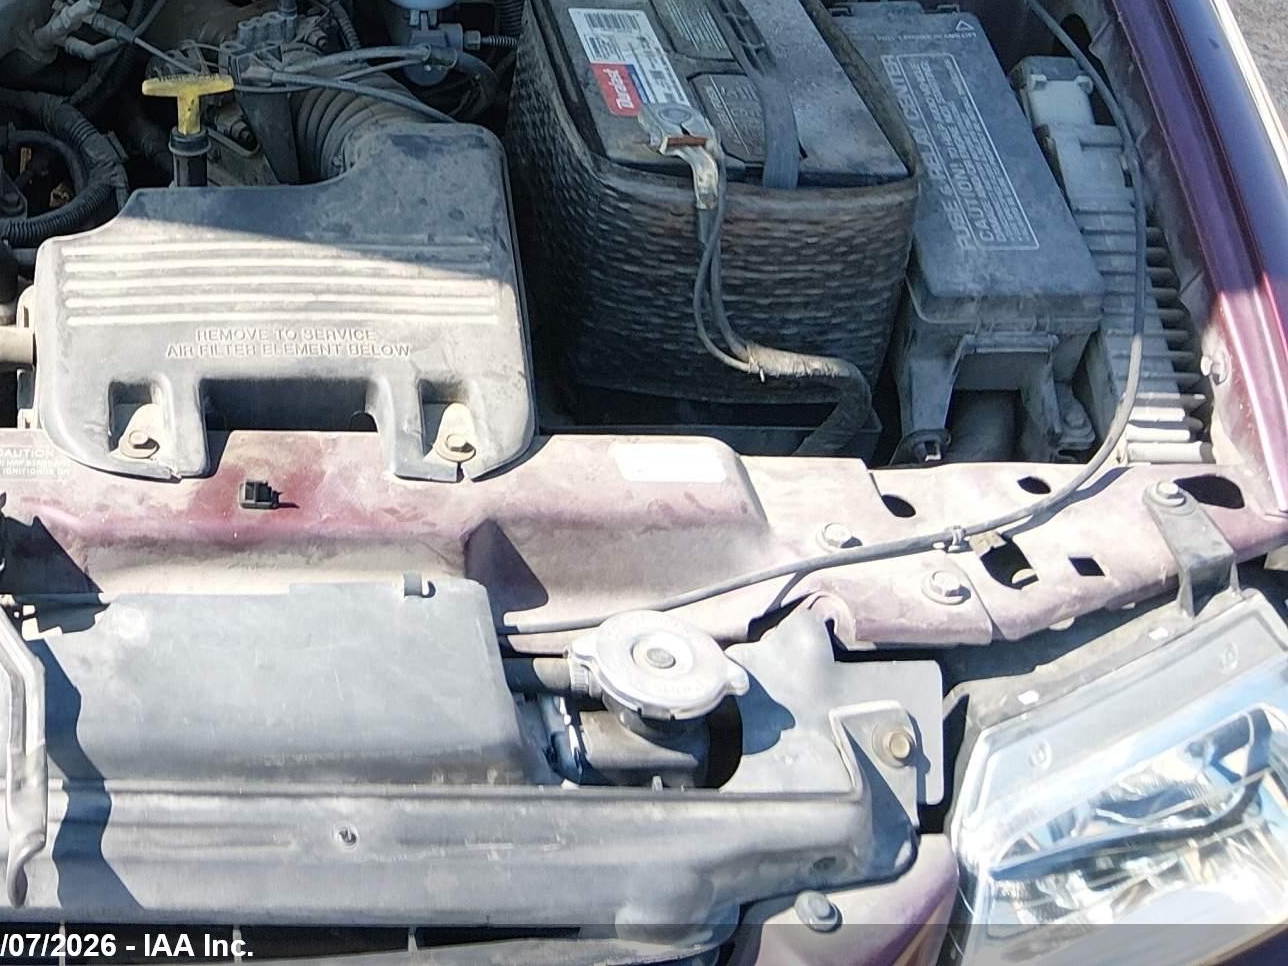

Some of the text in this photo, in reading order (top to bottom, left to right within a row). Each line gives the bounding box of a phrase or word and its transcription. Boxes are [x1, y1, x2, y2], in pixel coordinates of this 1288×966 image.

[878, 54, 921, 120] CENTER
[908, 125, 946, 178] RELAY
[940, 201, 976, 249] FUSE
[167, 343, 411, 357] AIR FILTER ELEMENT BELOW
[196, 328, 377, 342] REMOVE TO SERVICE
